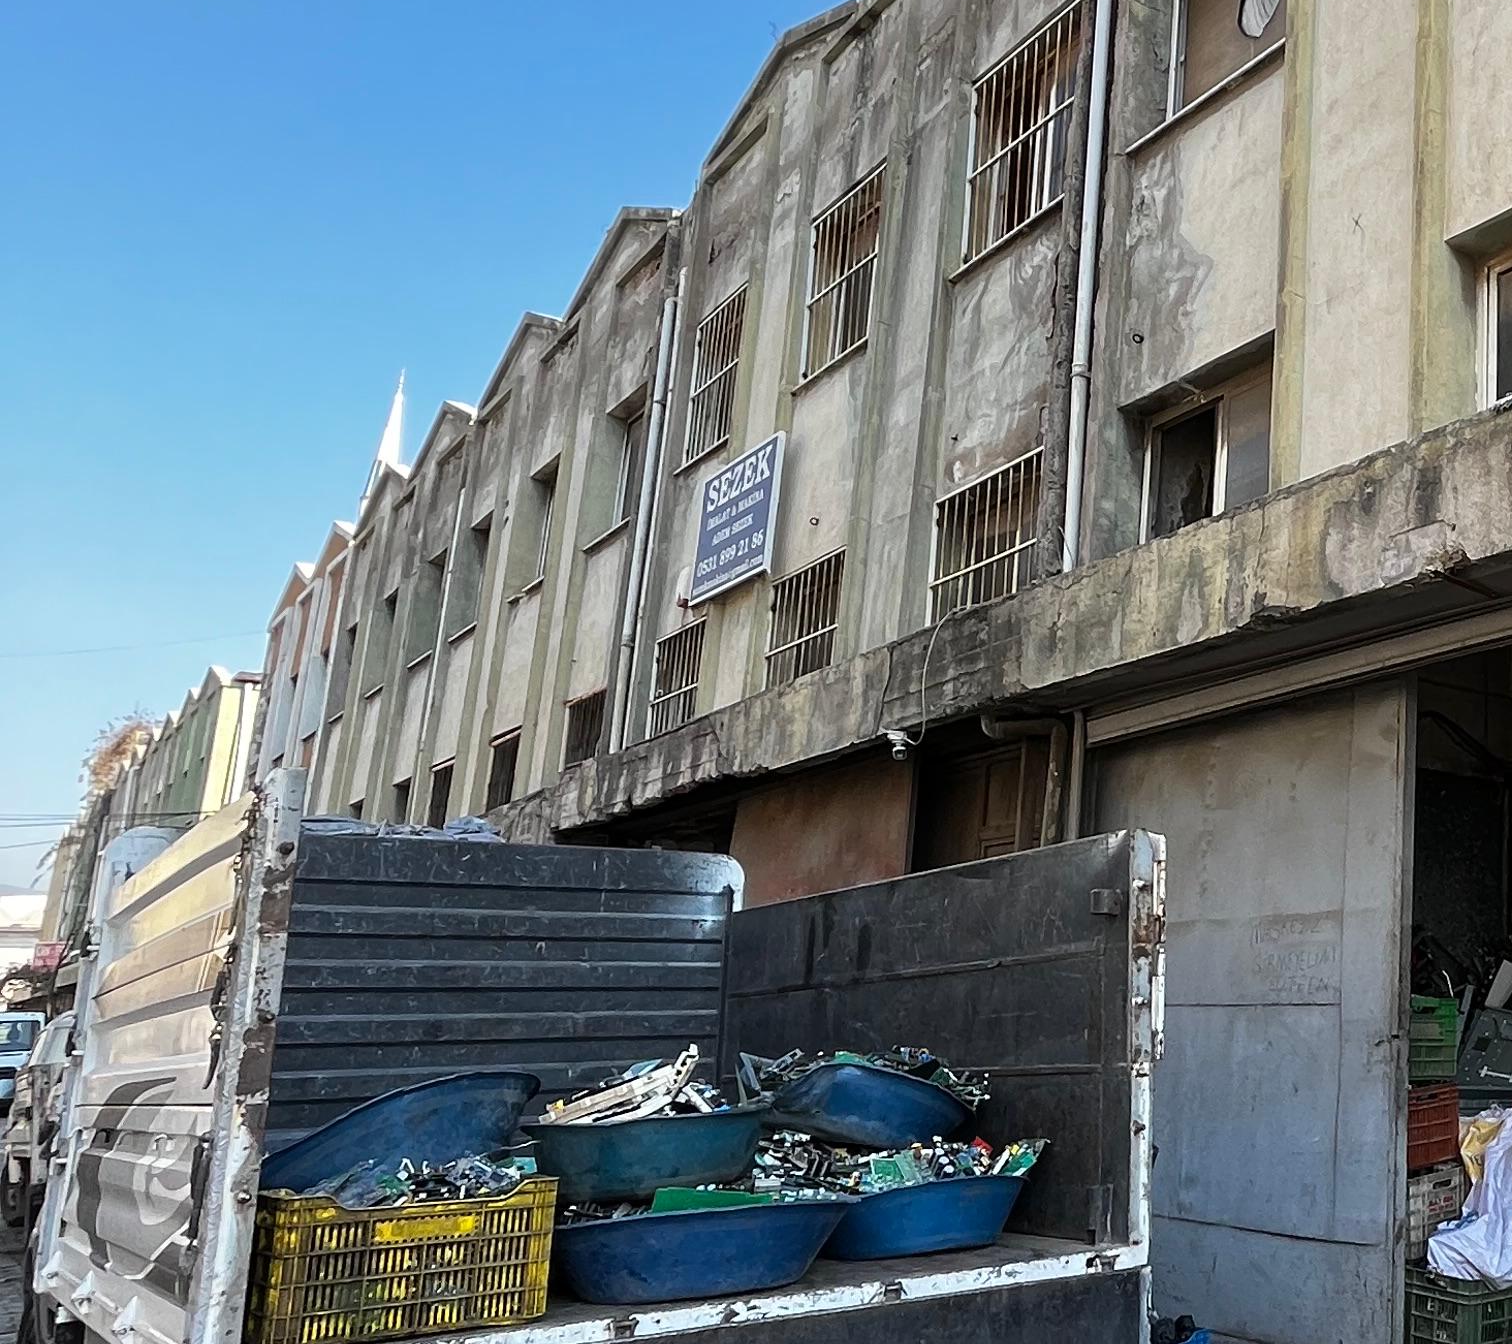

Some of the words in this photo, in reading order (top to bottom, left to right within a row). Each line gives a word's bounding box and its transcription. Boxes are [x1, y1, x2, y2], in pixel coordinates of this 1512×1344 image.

[706, 444, 773, 513] SEZEK
[696, 554, 718, 577] 0531
[719, 544, 736, 565] 899
[737, 537, 749, 556] 21
